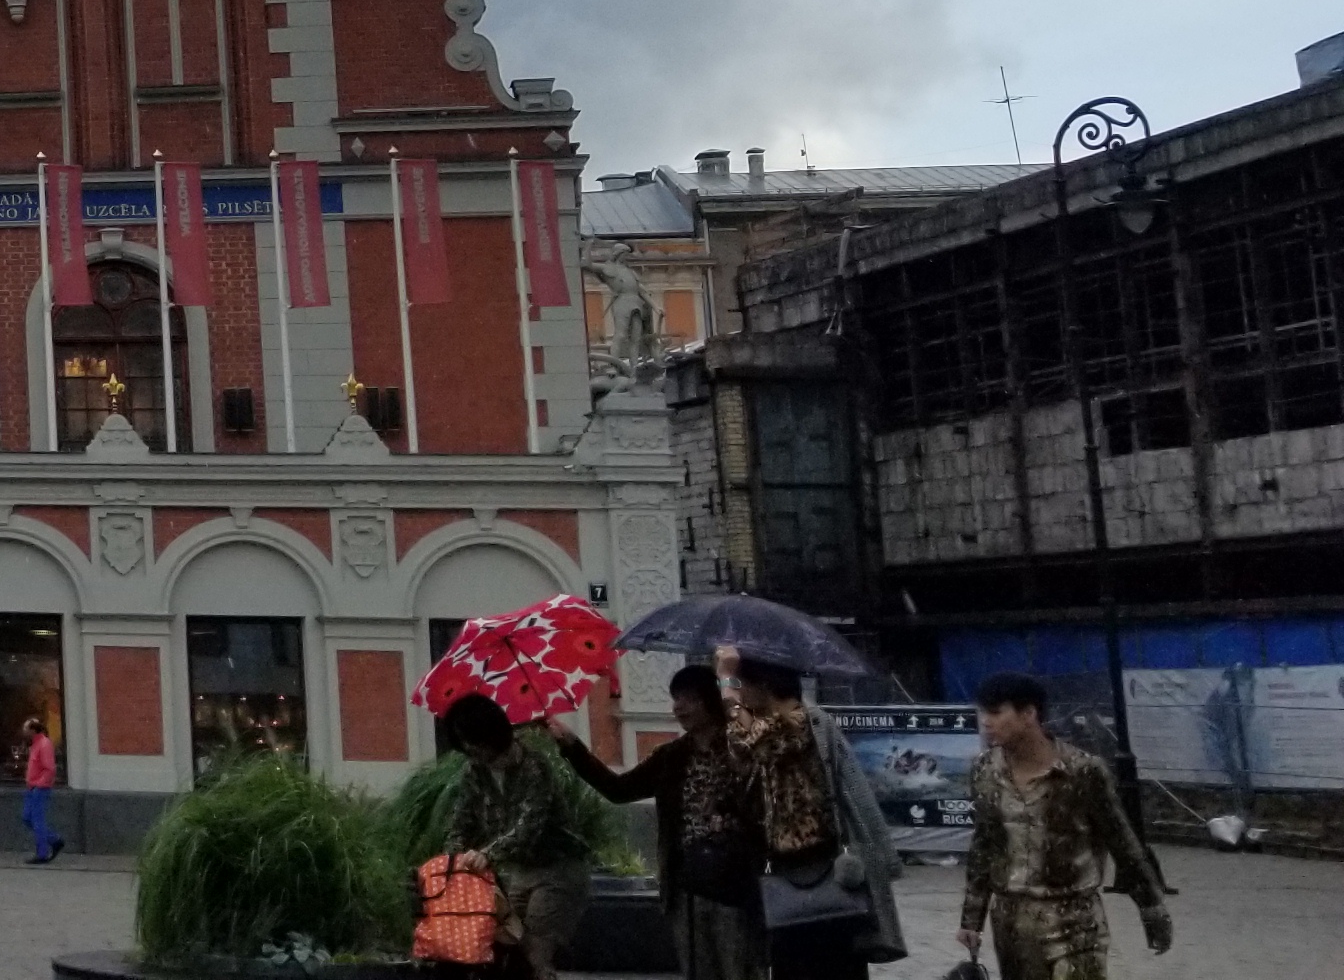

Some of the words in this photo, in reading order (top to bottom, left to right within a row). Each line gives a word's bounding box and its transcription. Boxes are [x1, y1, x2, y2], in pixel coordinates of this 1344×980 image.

[58, 171, 73, 263] WILLKOMMEN
[176, 169, 191, 237] WELCOME
[218, 200, 282, 214] PILSĒT
[293, 168, 310, 256] ПОЖАЛОВАТЬ
[300, 257, 316, 303] ДОБРО
[595, 587, 602, 598] 7
[835, 716, 895, 727] NO/CINEMA
[942, 814, 974, 825] RIGA
